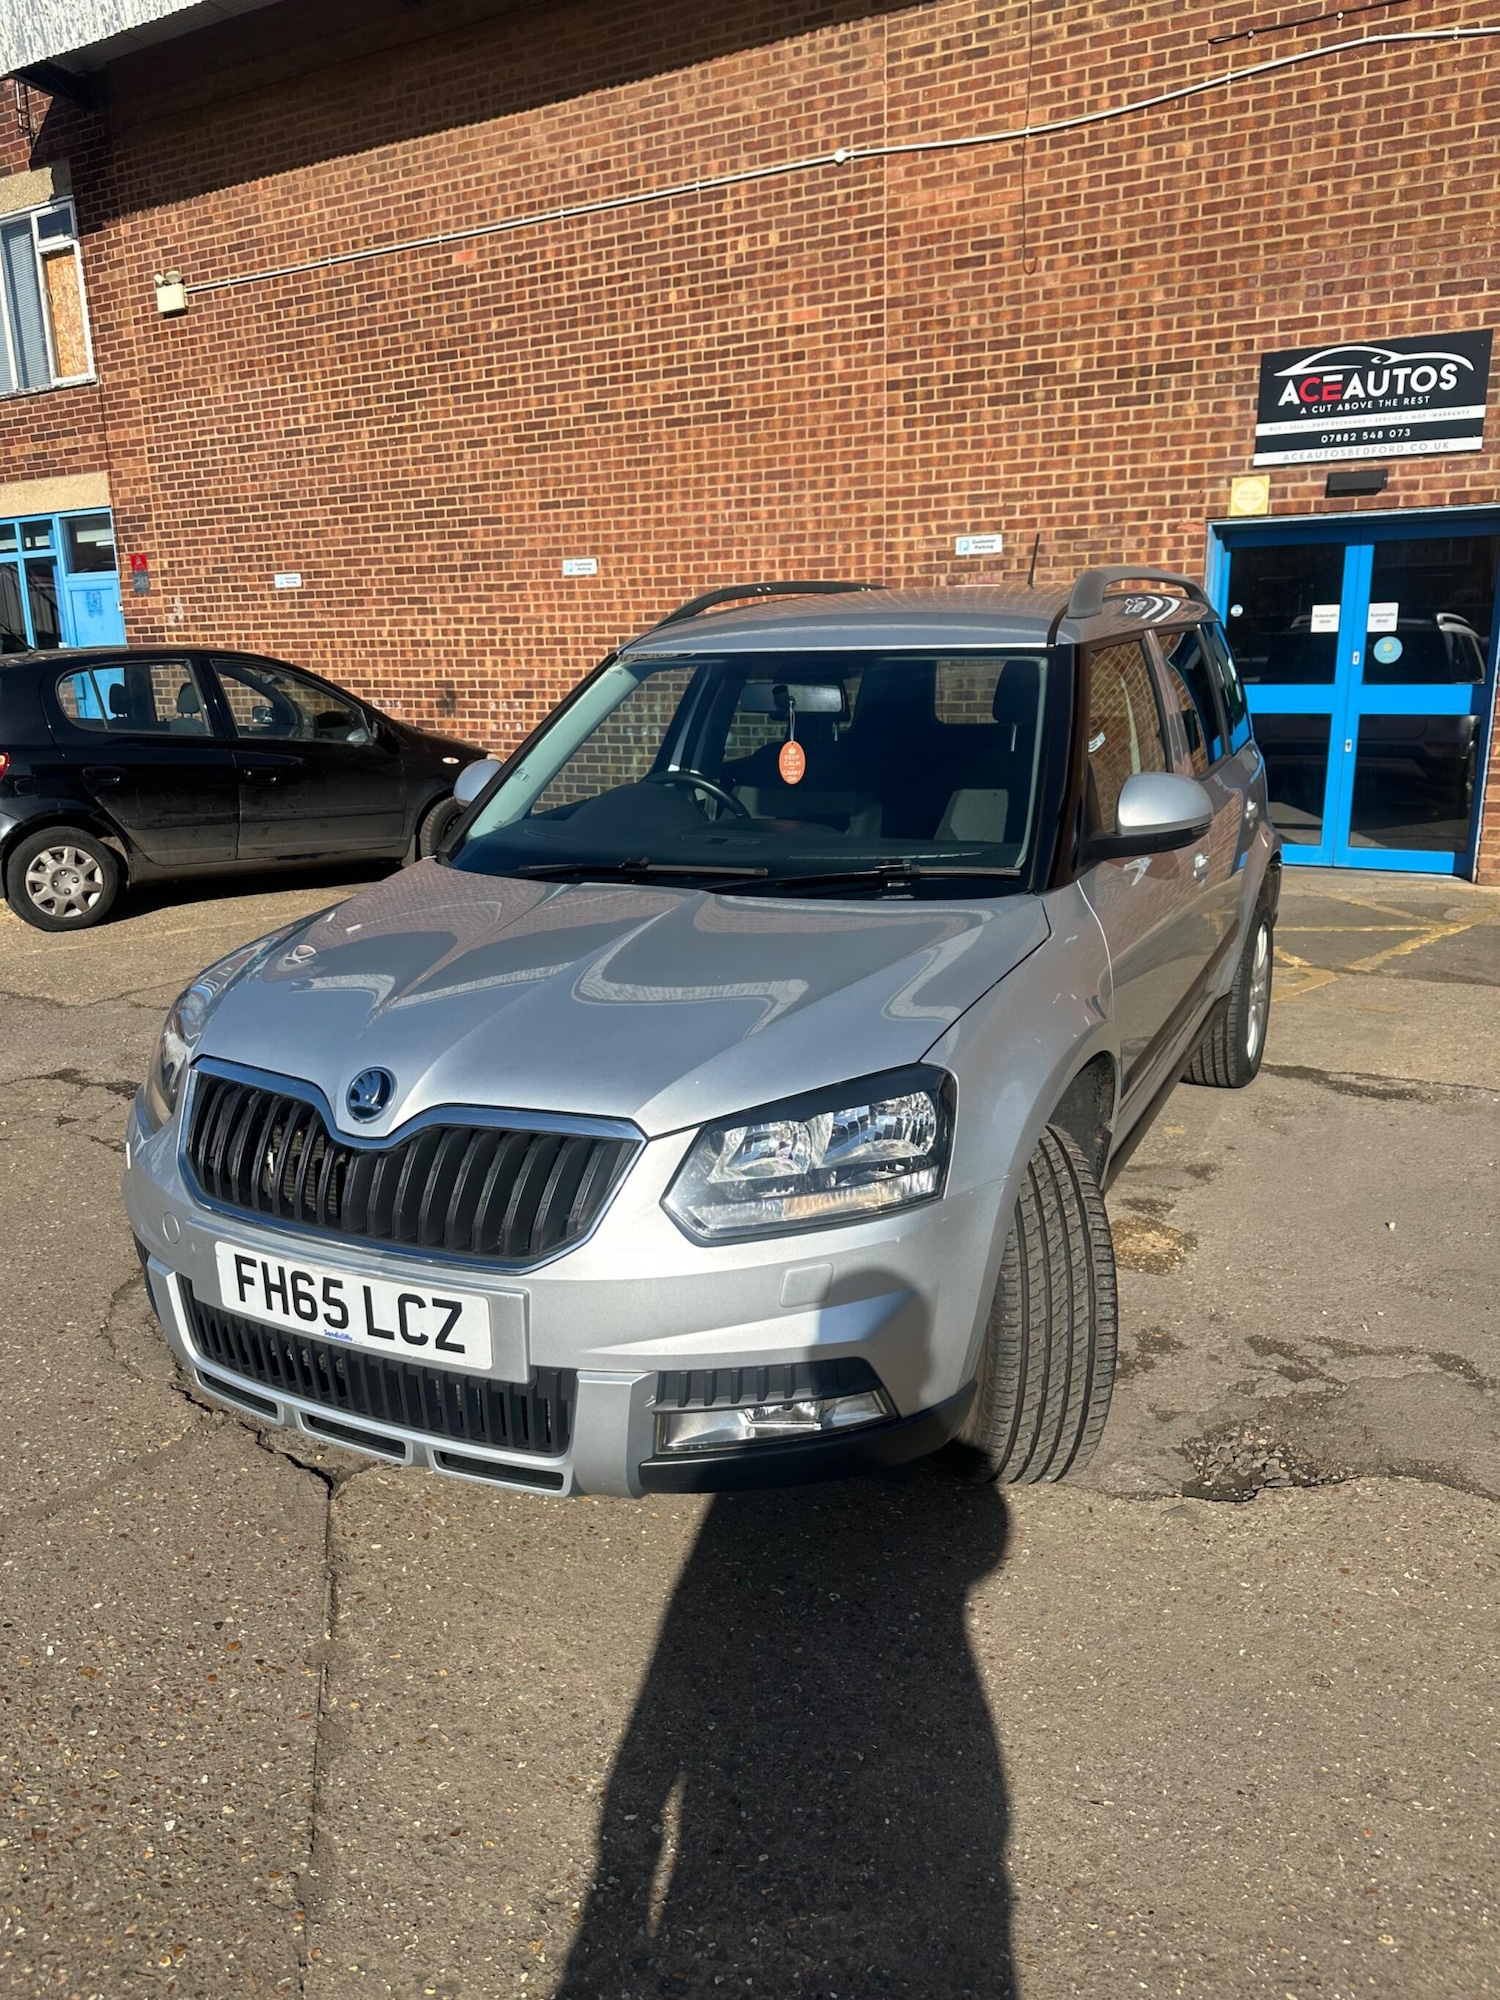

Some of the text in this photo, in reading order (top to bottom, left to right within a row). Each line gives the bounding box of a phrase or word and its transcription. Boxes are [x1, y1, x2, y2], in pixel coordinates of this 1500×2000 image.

[1312, 404, 1333, 414] CUT
[1337, 401, 1373, 411] ABOVE
[1378, 398, 1398, 407] THE
[1403, 396, 1430, 406] REST
[1331, 418, 1366, 426] EXCHANGE
[1321, 428, 1411, 443] 07882 548 073
[1283, 442, 1450, 461] ACEAUTOSBEDFORD.CO.UK
[234, 1253, 466, 1354] FH65 LCZ
